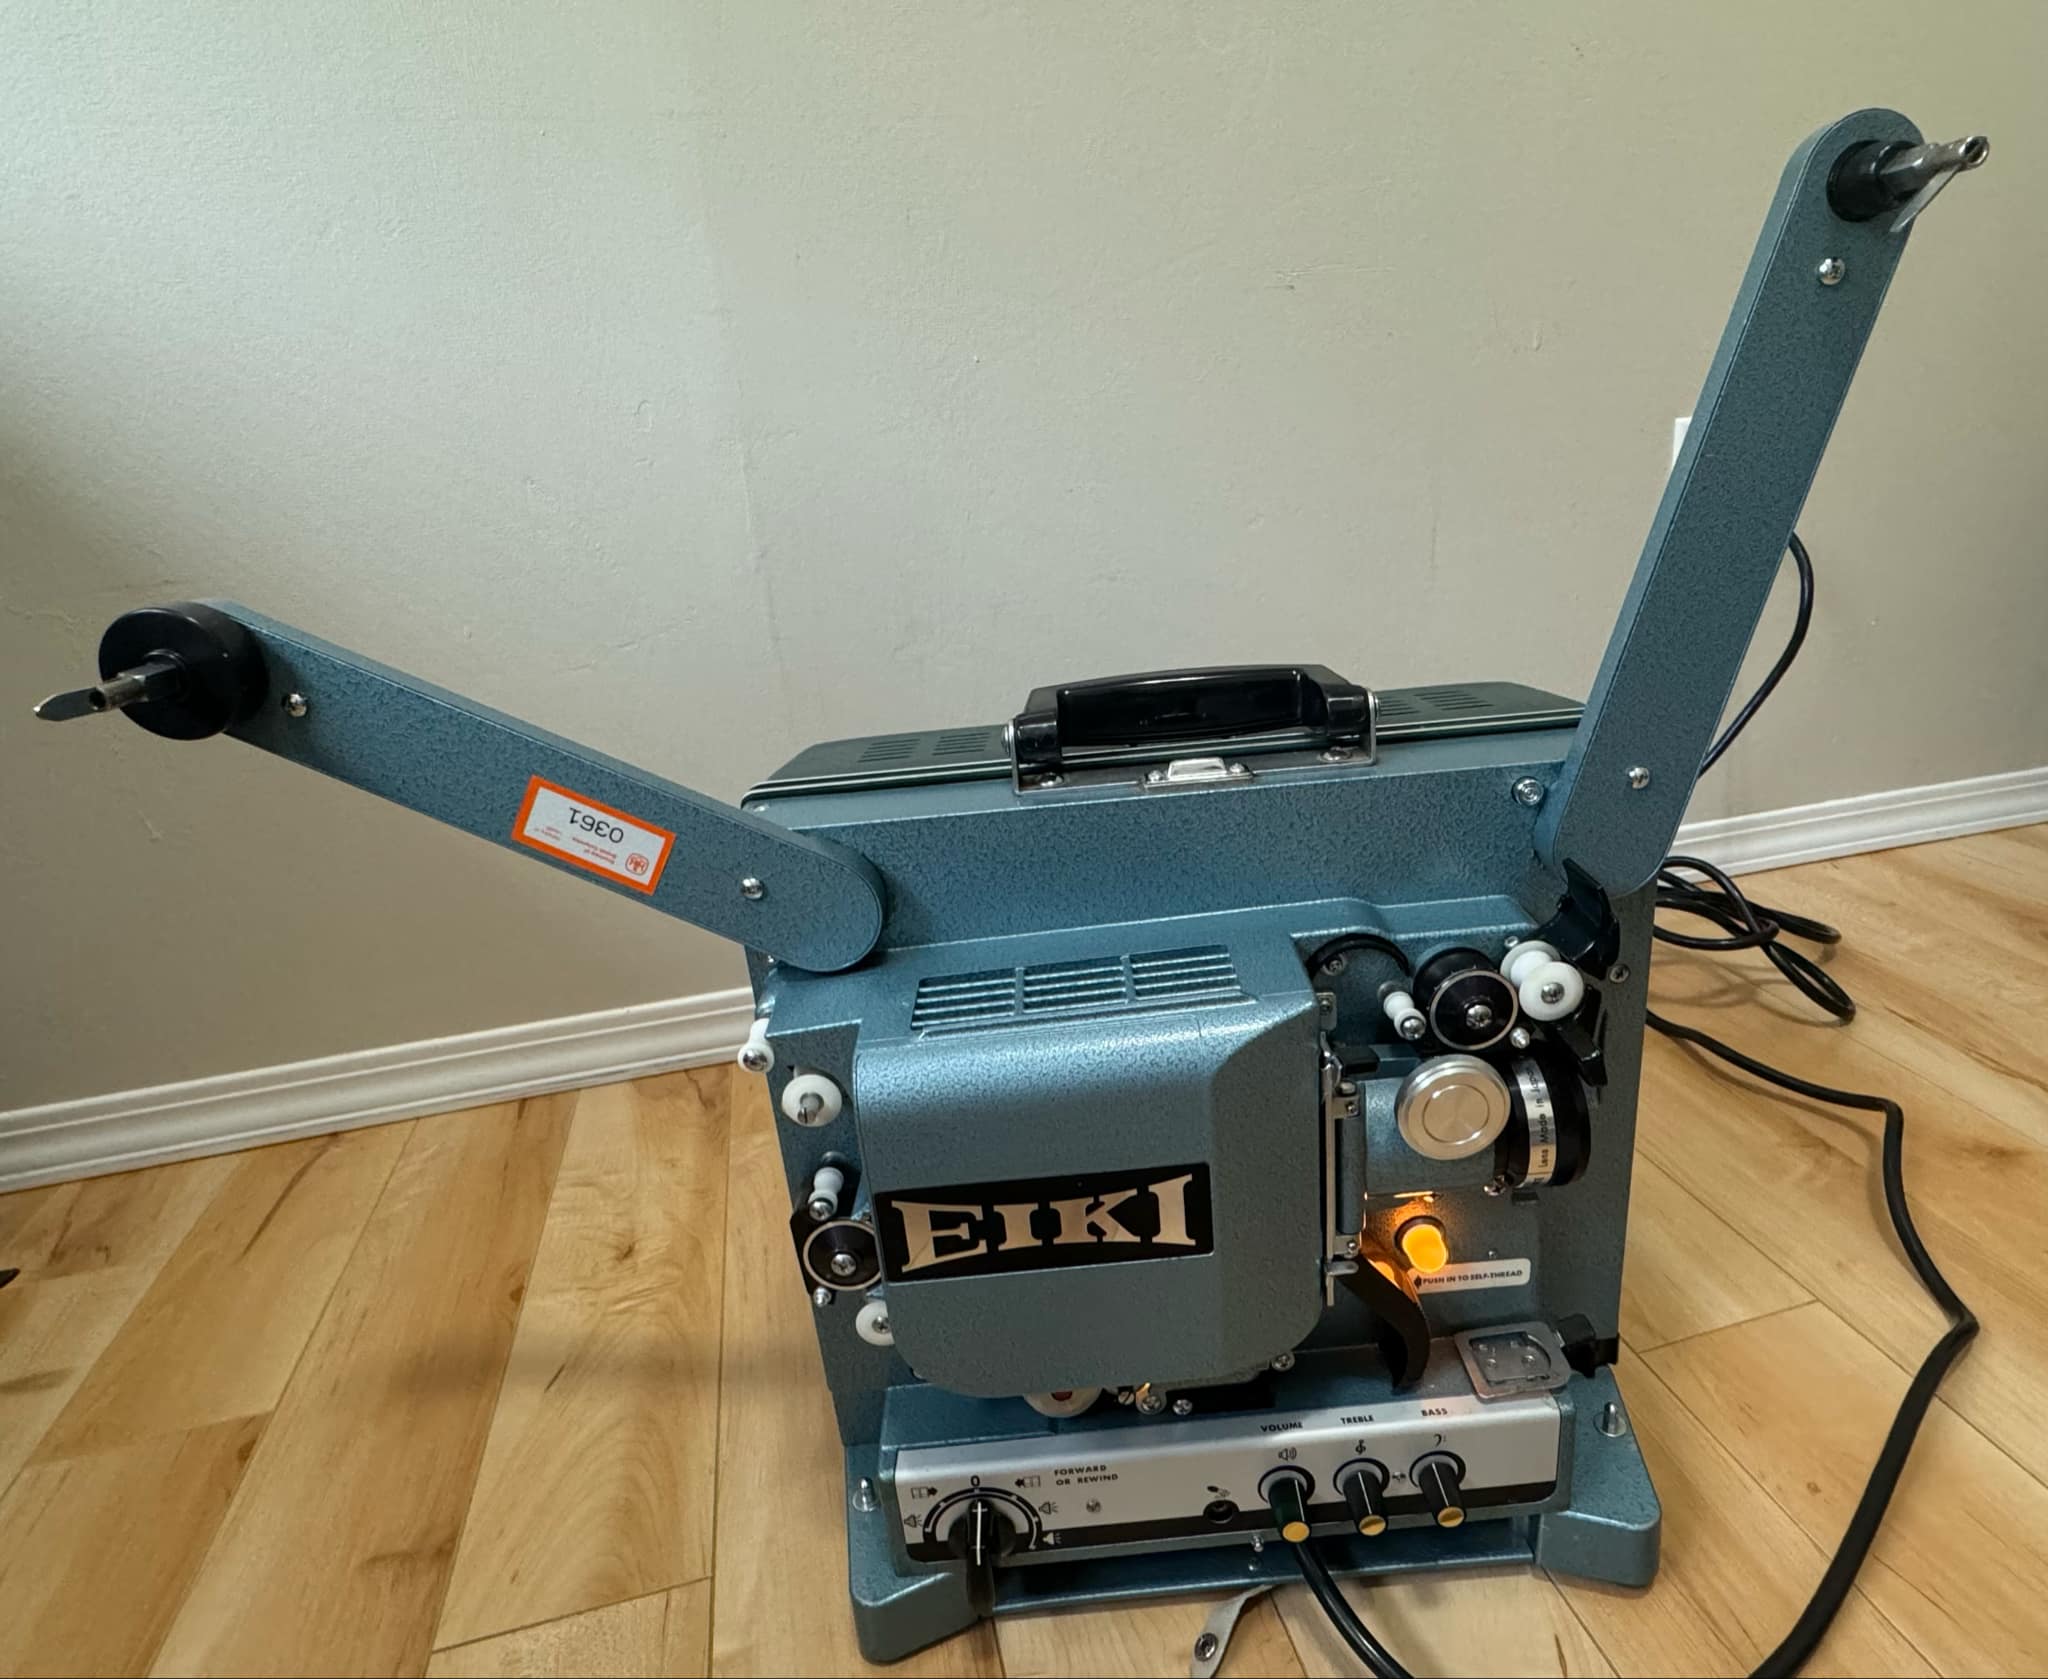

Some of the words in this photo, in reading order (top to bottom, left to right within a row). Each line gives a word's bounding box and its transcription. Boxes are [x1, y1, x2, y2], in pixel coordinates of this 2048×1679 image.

[569, 807, 624, 844] 0361
[891, 1173, 1197, 1273] EIKI
[1422, 1277, 1445, 1285] PUSH
[1457, 1274, 1470, 1282] TO
[1470, 1270, 1523, 1281] SELF-THREAD
[1420, 1407, 1448, 1417] BASS
[1340, 1414, 1374, 1425] TREBLE
[1260, 1421, 1303, 1433] VOLUME
[1054, 1464, 1108, 1477] FORWARD
[1055, 1477, 1073, 1486] OR
[1077, 1473, 1119, 1484] REWIND
